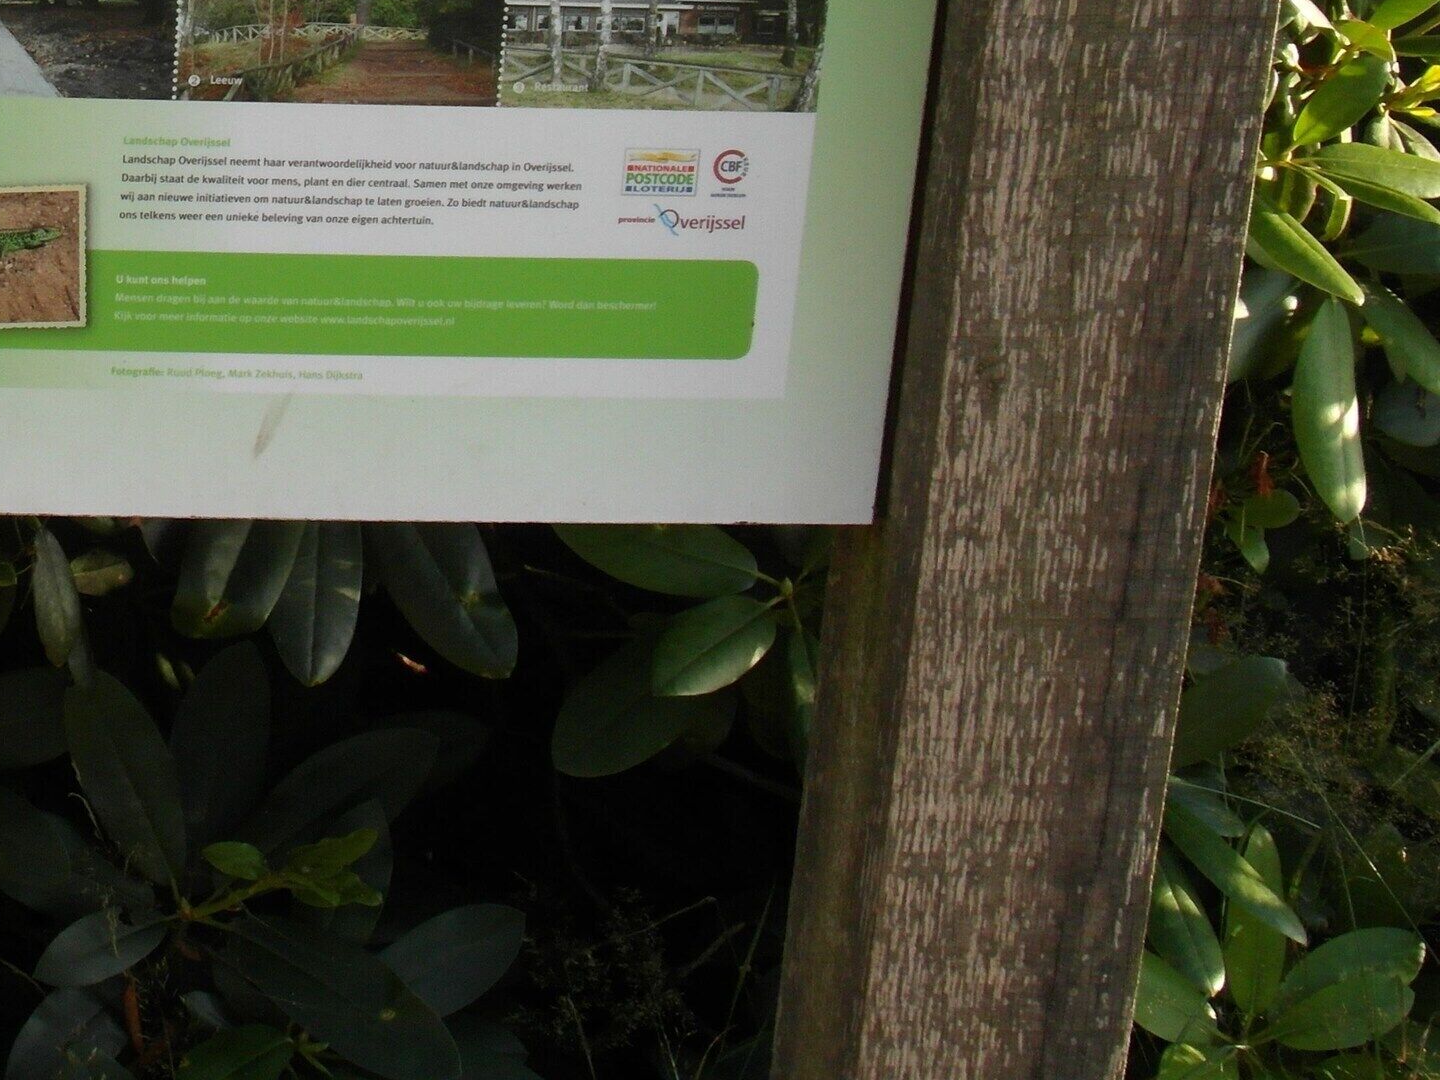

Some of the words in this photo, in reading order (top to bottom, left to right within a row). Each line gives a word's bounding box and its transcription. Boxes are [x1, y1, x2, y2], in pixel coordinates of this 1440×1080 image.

[210, 75, 243, 85] Leeuw
[123, 136, 179, 147] Landschap
[180, 137, 230, 148] Overijssel
[122, 154, 175, 166] Landschap
[178, 155, 226, 166] Overijssel
[230, 158, 260, 166] neemt
[263, 157, 285, 166] haar
[288, 159, 392, 169] verantwoordelijkheid
[418, 161, 509, 172] natuur&landschap
[523, 162, 573, 173] Overijssel.
[720, 160, 743, 172] CBF
[626, 173, 694, 185] POSTCODE
[618, 216, 655, 224] provincie
